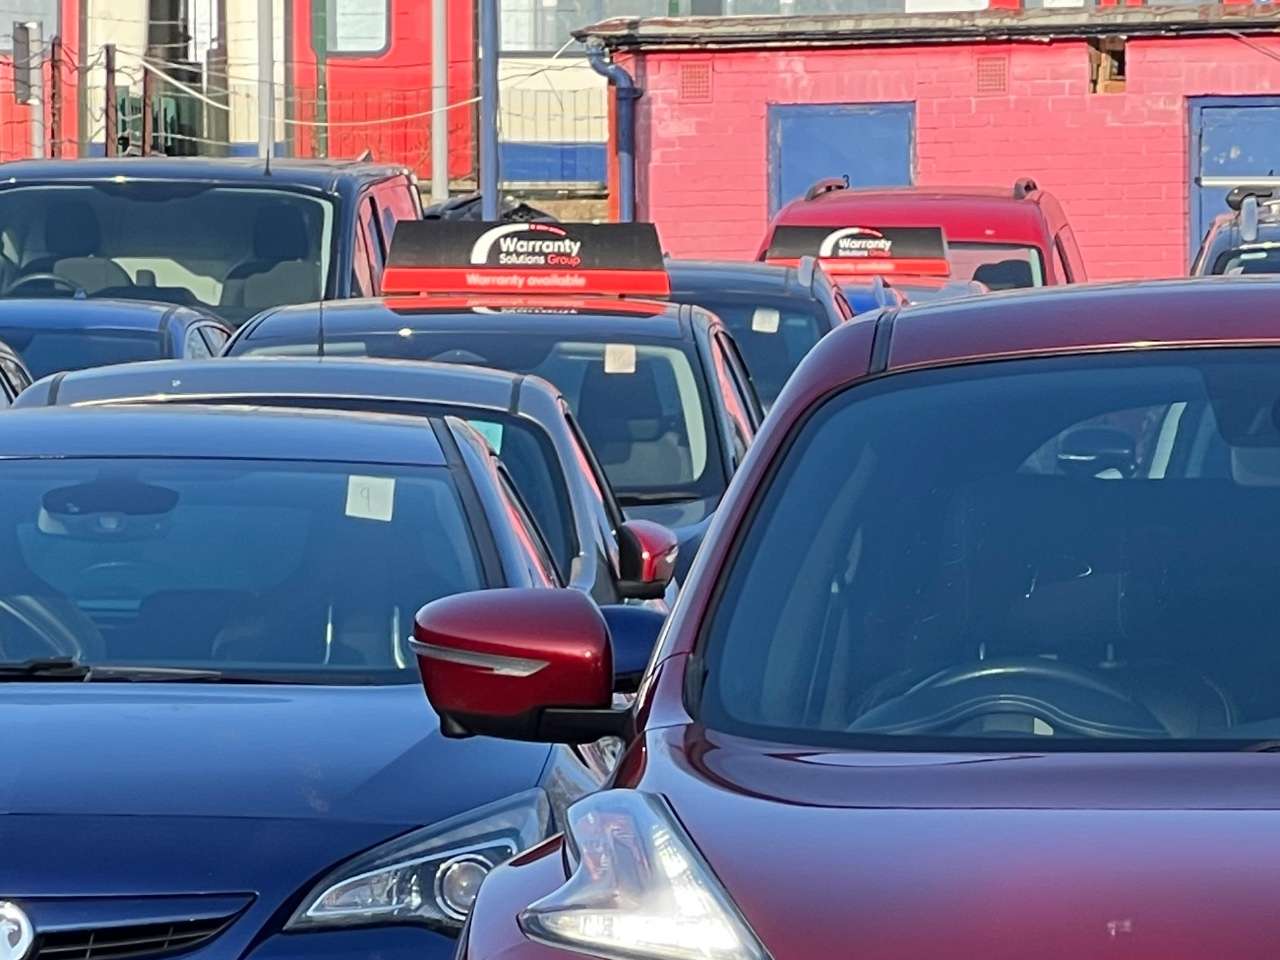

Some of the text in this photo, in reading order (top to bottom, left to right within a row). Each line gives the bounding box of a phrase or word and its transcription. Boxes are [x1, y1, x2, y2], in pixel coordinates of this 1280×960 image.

[499, 237, 581, 256] Warranty
[839, 238, 892, 252] Warranty
[499, 253, 581, 267] Solutions Group
[466, 274, 587, 287] Warranty available
